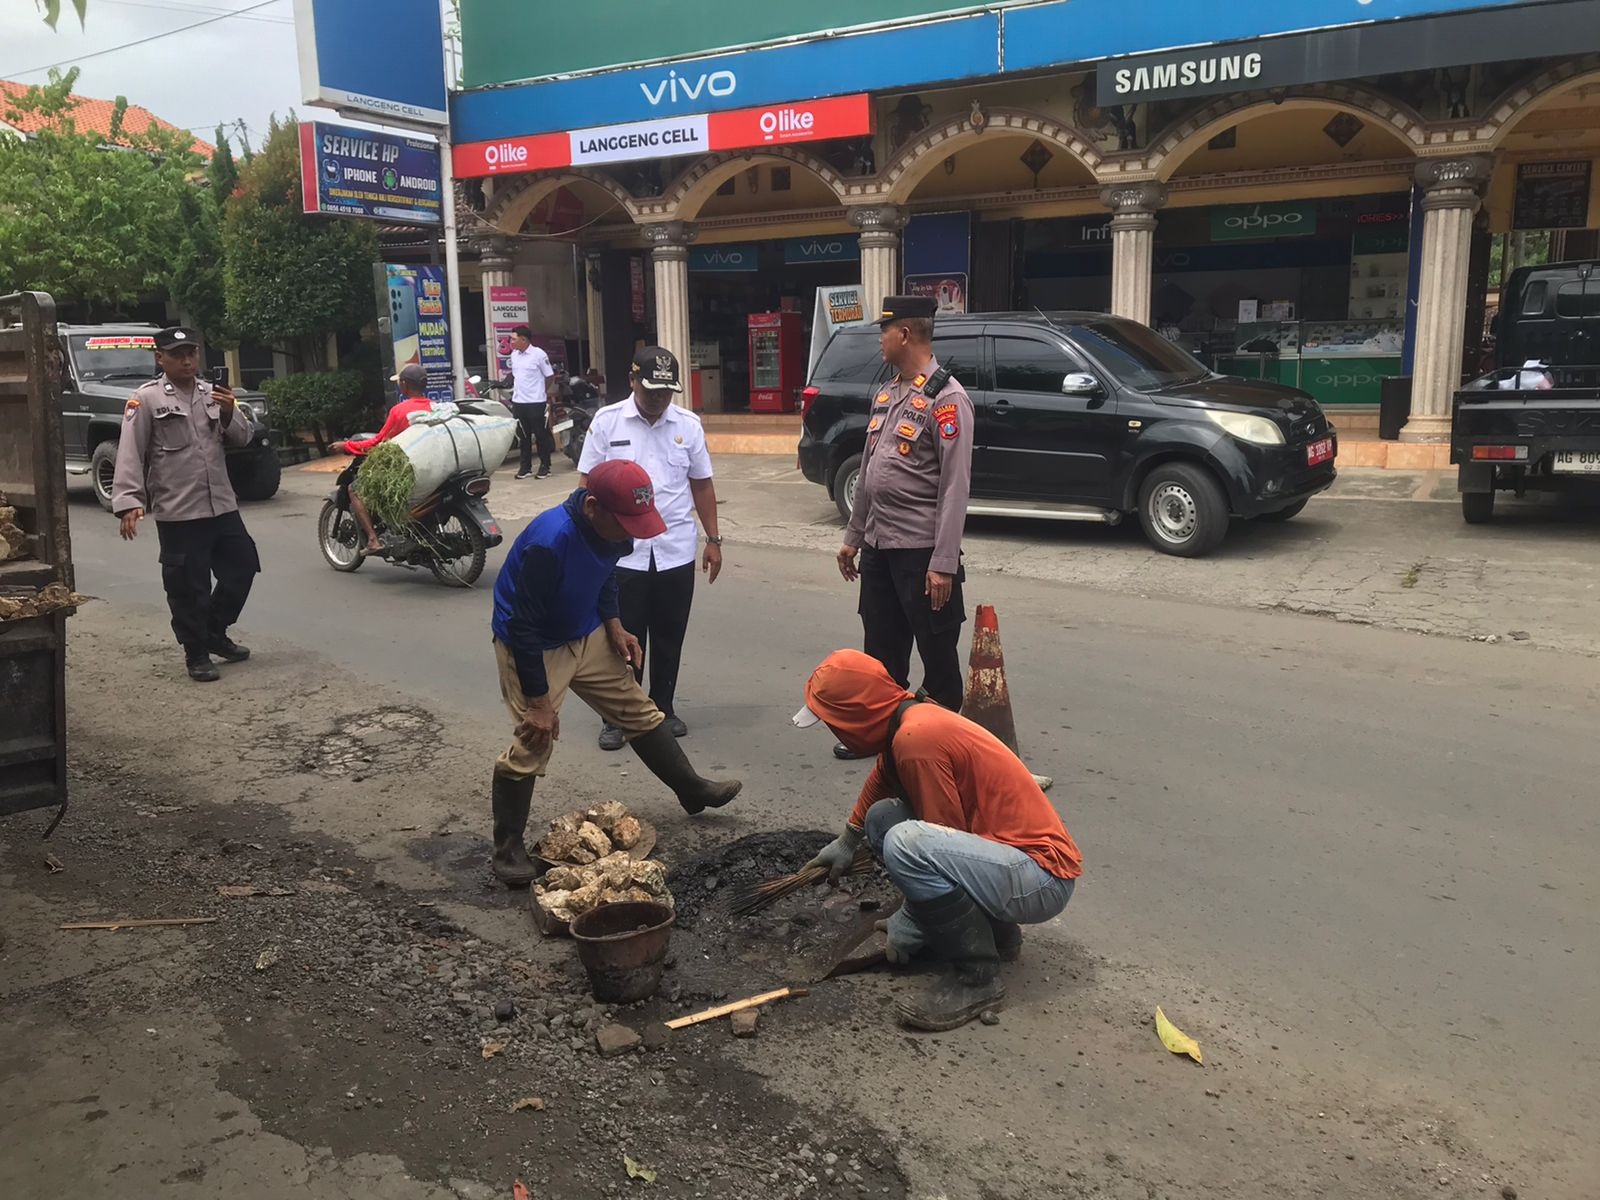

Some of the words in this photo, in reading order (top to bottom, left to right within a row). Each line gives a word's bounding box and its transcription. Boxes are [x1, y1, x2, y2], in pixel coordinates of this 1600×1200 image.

[1115, 53, 1261, 94] SAMSUNG
[640, 70, 736, 105] vivo
[346, 94, 400, 112] LANGGENG
[402, 106, 424, 117] CELL
[323, 135, 378, 161] SERVICE
[382, 144, 400, 164] HP
[579, 132, 659, 155] LANGGENG
[661, 127, 699, 145] CELL
[343, 167, 377, 184] IPHONE
[400, 175, 437, 191] ANDROID
[1224, 213, 1303, 230] oppo
[800, 240, 843, 256] vivo
[704, 249, 743, 265] vivo
[830, 291, 858, 307] SERVICE
[418, 321, 446, 336] MUDAH
[902, 409, 927, 426] POLRI
[1557, 451, 1573, 463] AG
